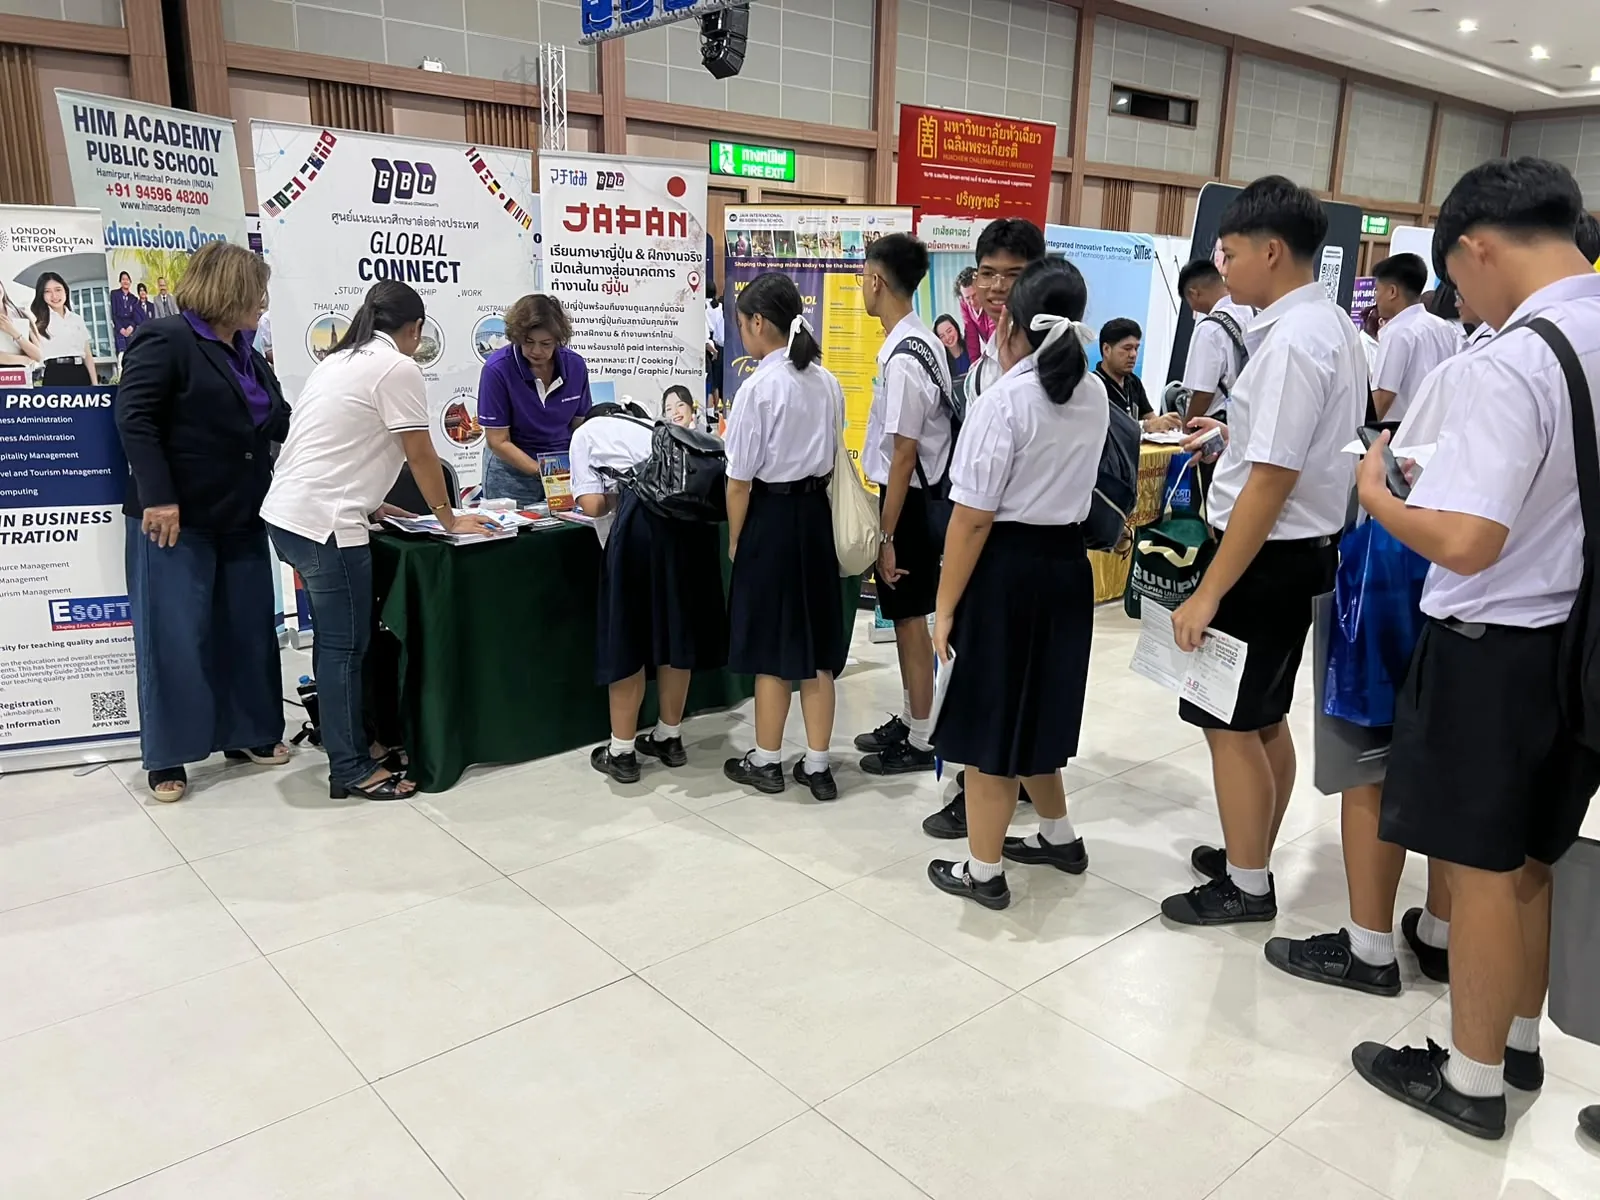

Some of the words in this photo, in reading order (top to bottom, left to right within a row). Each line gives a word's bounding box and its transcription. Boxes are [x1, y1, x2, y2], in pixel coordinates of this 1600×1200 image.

[73, 105, 117, 137] HIM
[124, 114, 221, 153] ACADEMY
[944, 119, 1042, 145] มหาวิทยาลัยหัวเฉียว
[943, 135, 1018, 159] เฉลิมพระเกียรติ
[86, 140, 149, 168] PUBLIC
[154, 152, 218, 177] SCHOOL
[96, 168, 132, 181] Hamirpur,
[134, 172, 163, 184] Himachal
[166, 176, 191, 186] Pradesh
[192, 179, 214, 190] (INDIA)
[373, 162, 435, 198] GBC
[550, 168, 587, 186] マチなみ
[742, 166, 764, 178] FIRE
[765, 167, 786, 179] EXIT
[597, 172, 624, 190] GBC
[106, 183, 130, 197] +91
[136, 185, 172, 201] 94596
[176, 189, 208, 205] 48200
[956, 190, 1000, 210] ปริญญาตรี
[120, 201, 200, 216] www.himacademy.com
[331, 210, 479, 229] ศูนย์แนะแนวศึกษาต่อต่างประเทศ
[563, 202, 687, 238] JAPAN
[10, 227, 56, 235] LONDON
[12, 236, 93, 245] METROPOLITAN
[370, 230, 448, 257] GLOBAL
[1075, 242, 1102, 251] Innovative
[1103, 245, 1132, 254] Technology
[550, 243, 633, 263] เรียนภาษาญี่ปุ่น
[636, 249, 645, 260] &
[648, 247, 702, 263] ฝึกงานจริง
[358, 258, 460, 284] CONNECT
[551, 263, 675, 280] เปิดเส้นทางสู่อนาคตการ
[338, 287, 364, 295] STUDY
[552, 279, 598, 292] ทำงานใน
[601, 277, 628, 295] ญี่ปุ่น
[313, 303, 349, 311] THAILAND
[626, 344, 644, 352] paid
[646, 344, 685, 353] internship
[906, 340, 935, 366] SCHOOL
[641, 358, 674, 366] Cooking
[605, 367, 632, 375] Manga
[638, 367, 668, 376] Graphic
[675, 368, 702, 376] Nursing
[6, 394, 112, 409] PROGRAMS
[16, 416, 73, 424] Administration
[0, 453, 28, 461] pitality
[29, 452, 79, 460] Management
[62, 468, 111, 477] Management
[0, 488, 38, 497] omputing
[22, 511, 112, 526] BUSINESS
[0, 529, 78, 544] TRATION
[20, 561, 70, 571] Management
[1134, 561, 1171, 589] BUU
[22, 588, 72, 596] Management
[52, 600, 130, 622] ESOFT
[18, 641, 28, 650] for
[31, 640, 65, 650] teaching
[66, 638, 93, 647] quality
[64, 660, 98, 668] recognised
[20, 669, 53, 678] University
[0, 699, 54, 710] Registration
[6, 719, 61, 729] Information
